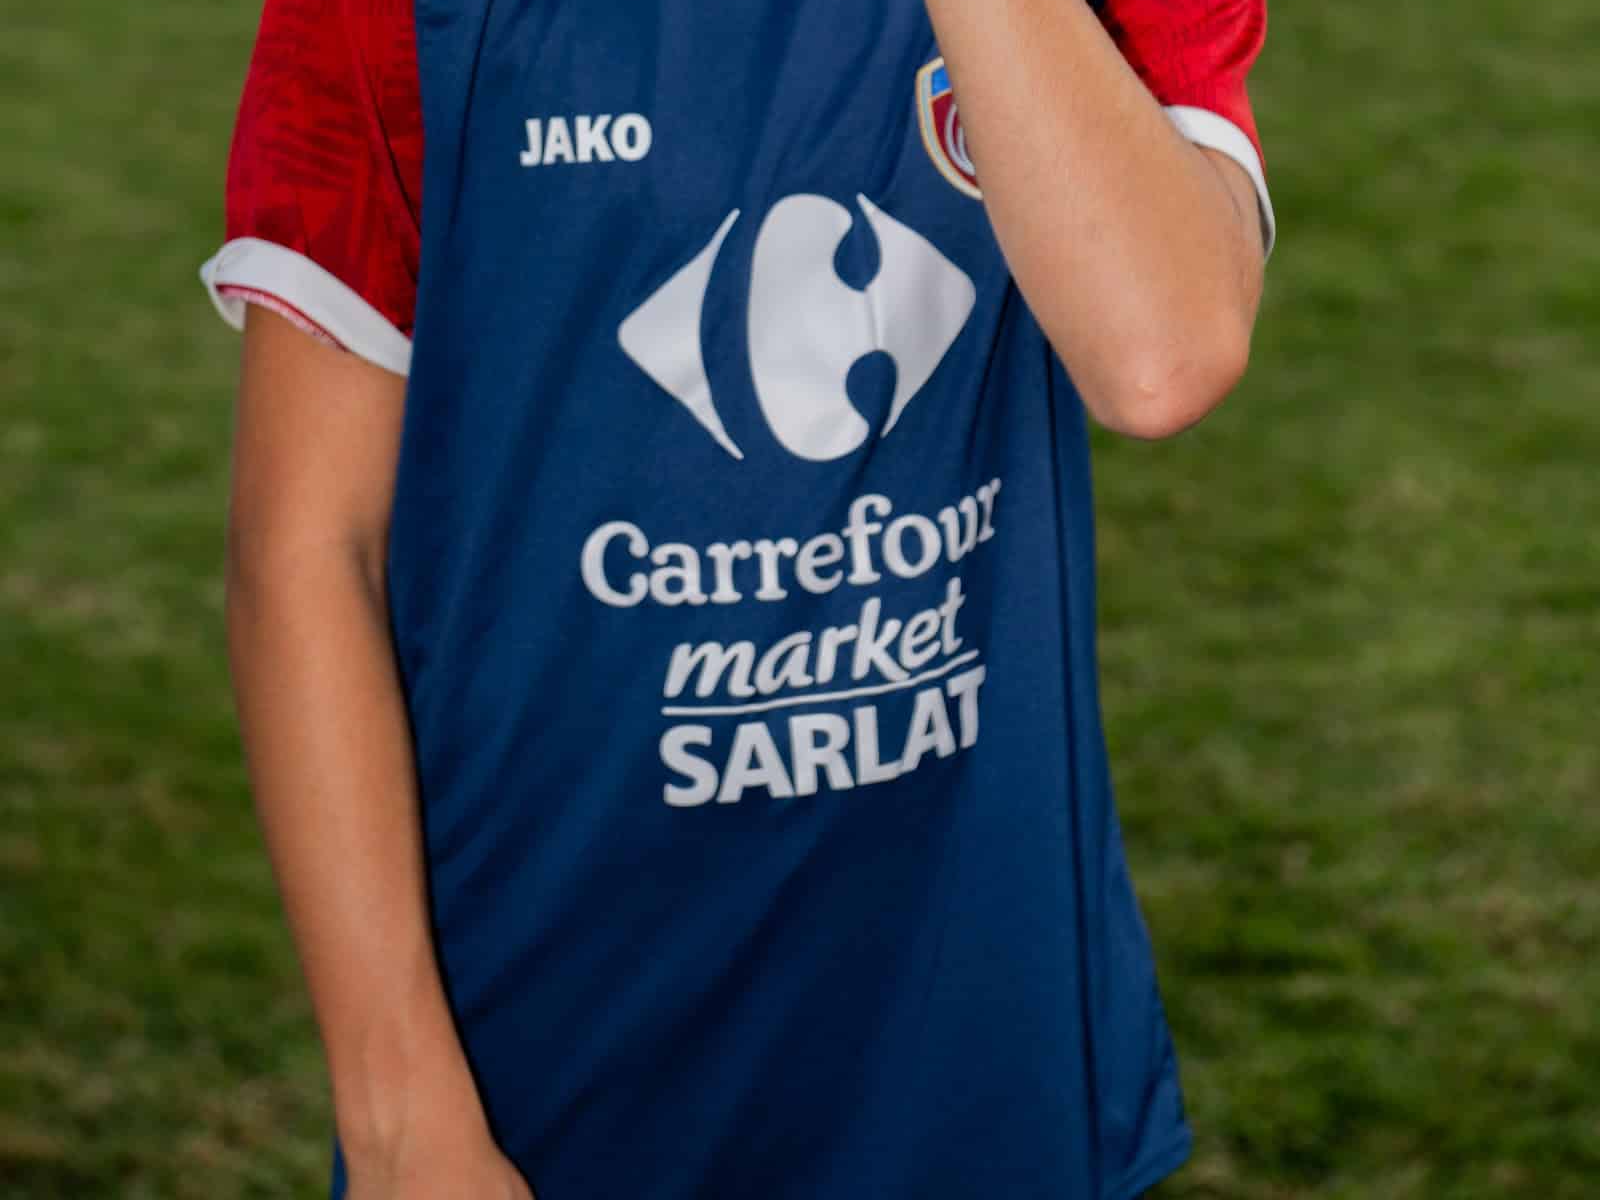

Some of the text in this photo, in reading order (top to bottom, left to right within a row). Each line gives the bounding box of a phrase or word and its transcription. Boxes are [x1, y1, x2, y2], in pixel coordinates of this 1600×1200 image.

[519, 112, 653, 167] JAKO
[580, 477, 1001, 608] Carrefour
[663, 576, 966, 698] market
[658, 664, 986, 808] SARLAT
